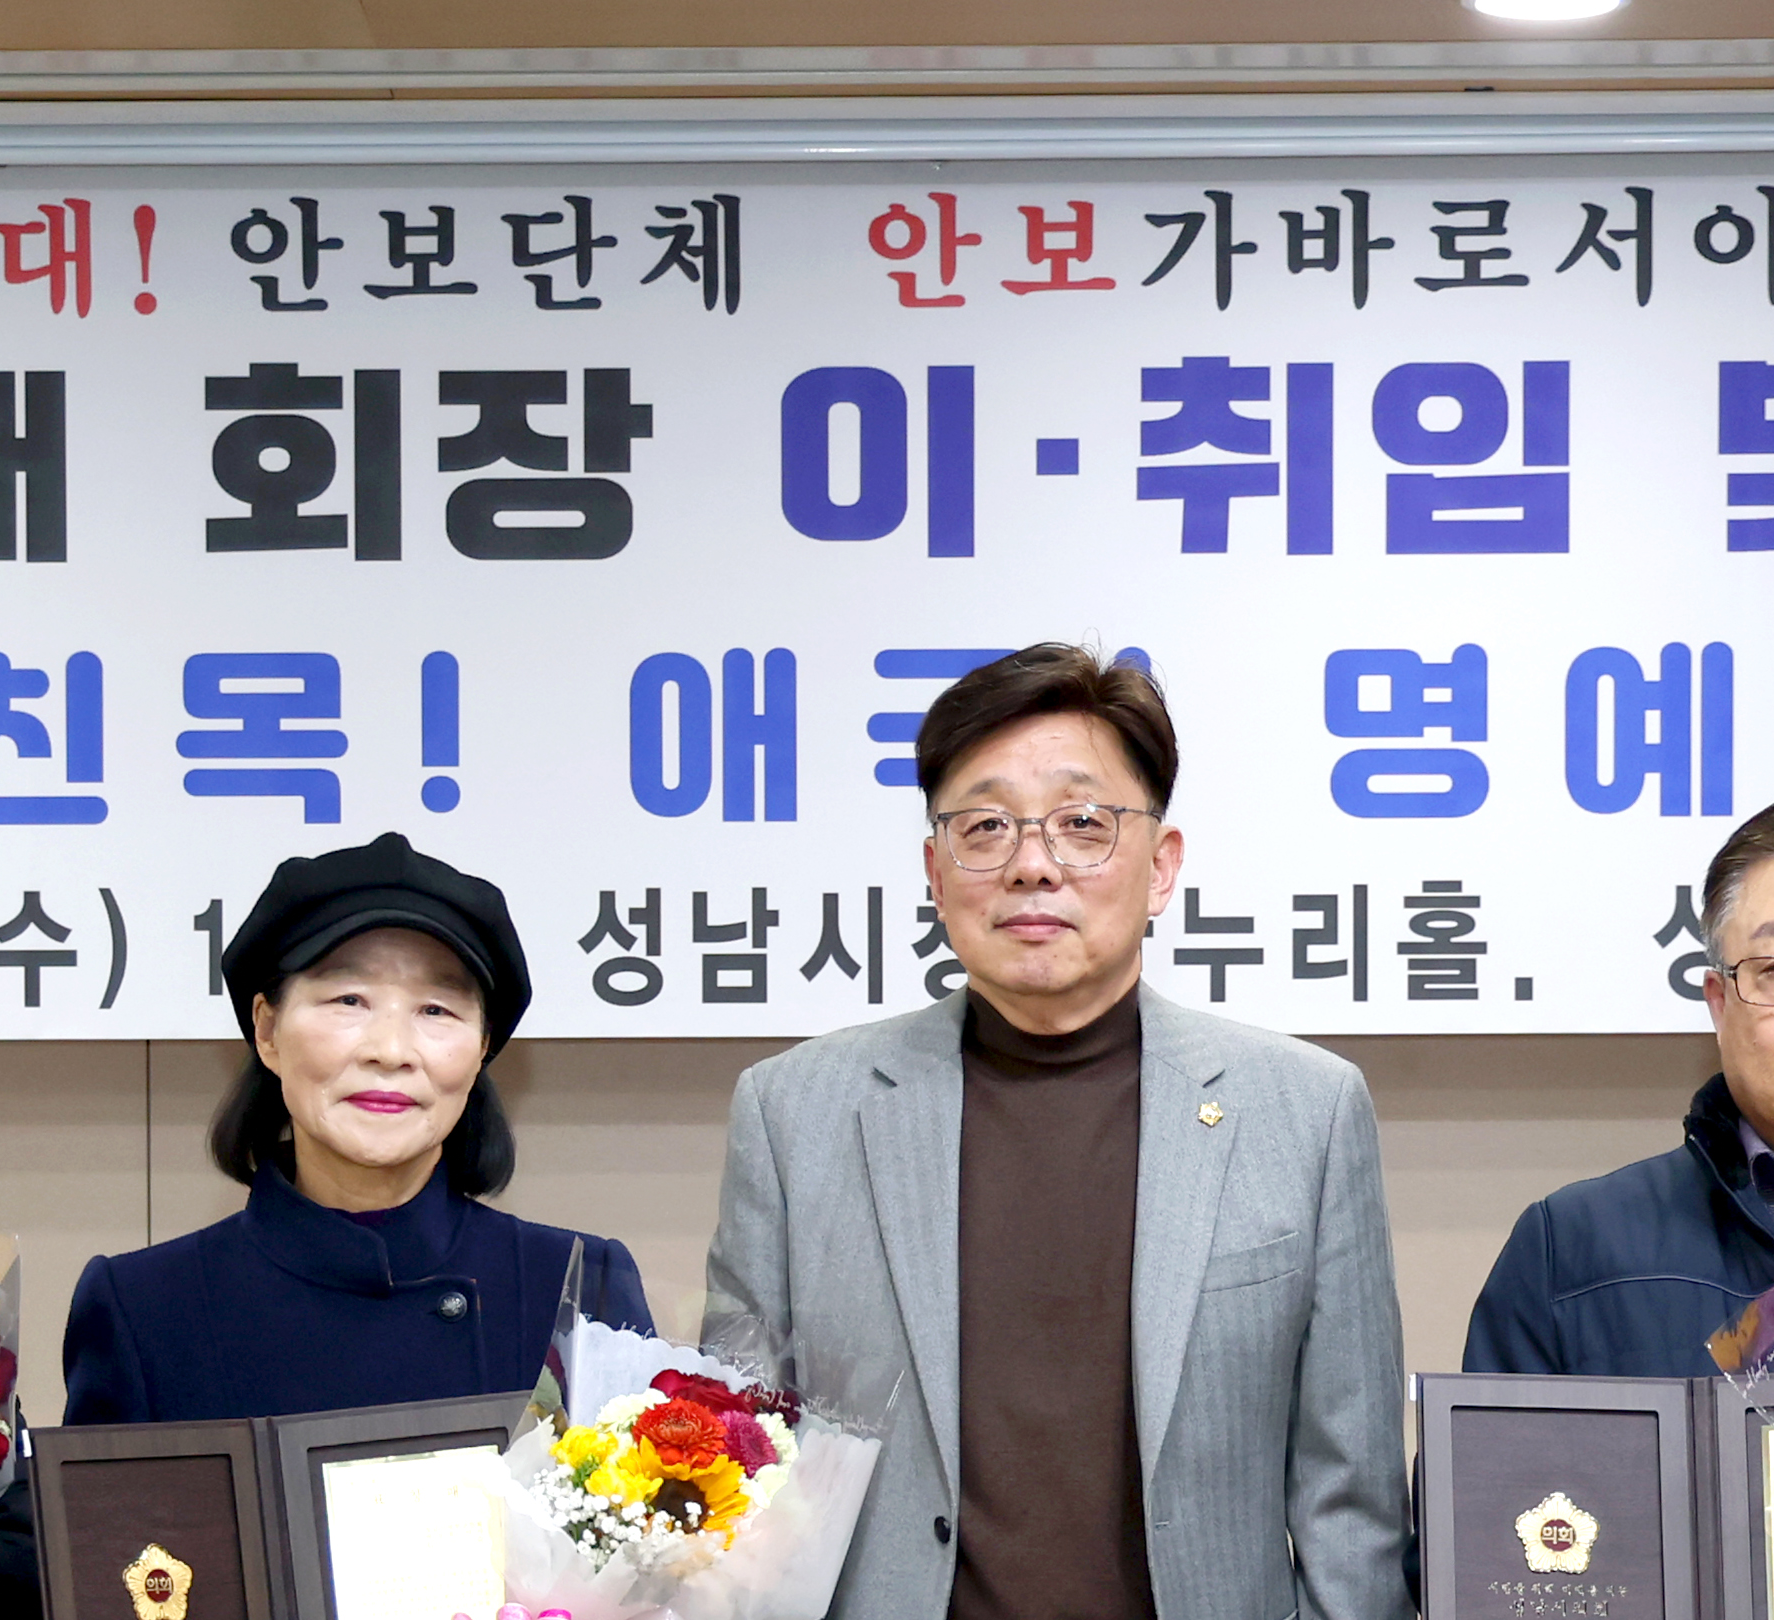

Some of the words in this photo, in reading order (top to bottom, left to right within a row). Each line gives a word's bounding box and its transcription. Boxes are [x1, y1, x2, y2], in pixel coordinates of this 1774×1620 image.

[231, 194, 740, 315] 안보단체
[205, 362, 653, 561] 회장
[1144, 880, 1533, 1002] 누리홀.
[146, 1576, 173, 1594] 의회
[1542, 1526, 1574, 1545] 의회
